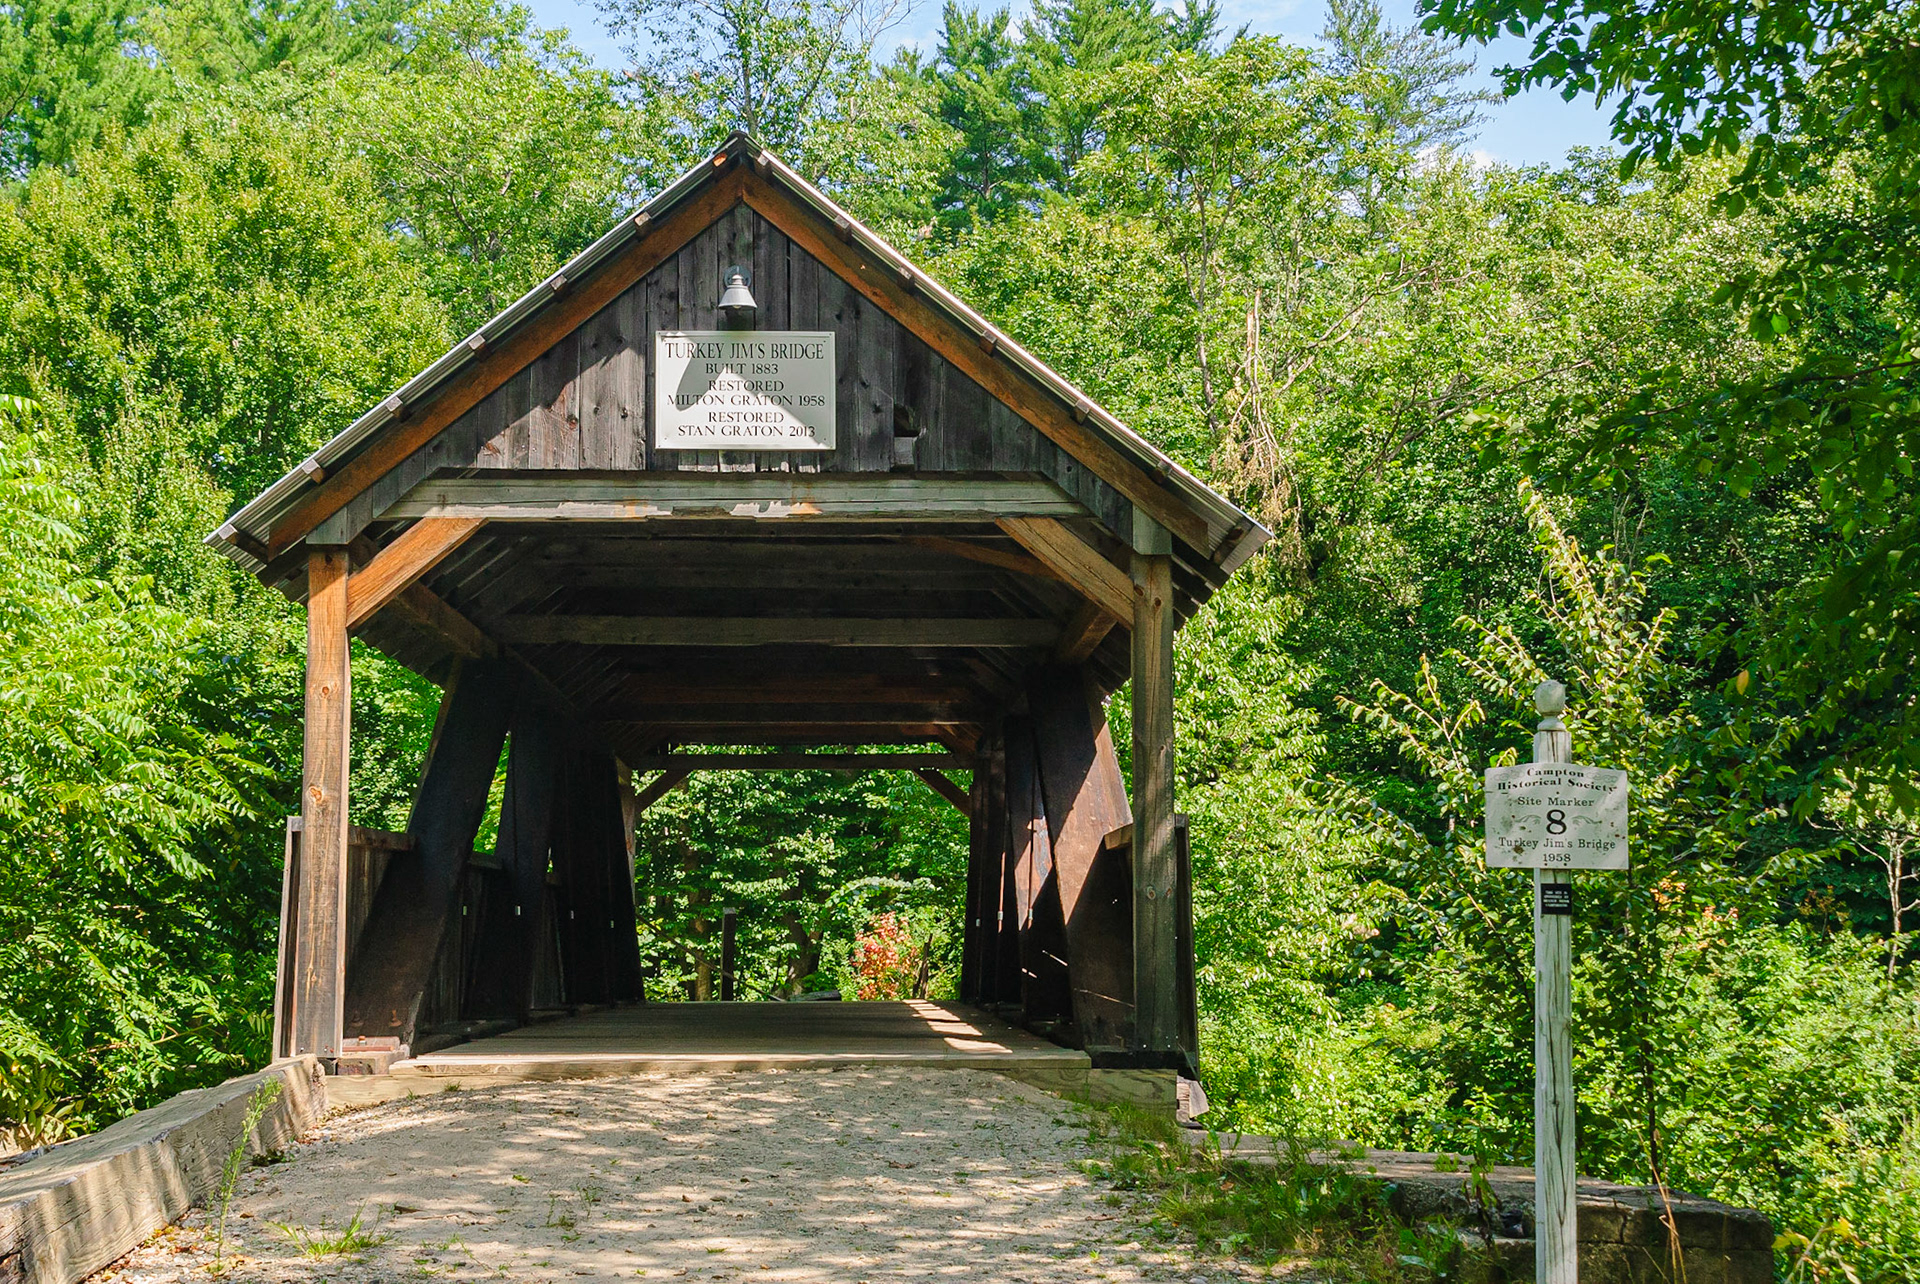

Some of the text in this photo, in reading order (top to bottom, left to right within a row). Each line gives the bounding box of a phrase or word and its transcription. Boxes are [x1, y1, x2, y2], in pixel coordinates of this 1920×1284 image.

[665, 342, 824, 359] TURKEY JIM'S BRIDGE
[705, 363, 779, 374] BUILT 1883
[708, 380, 784, 392] RESTORED
[667, 394, 826, 406] MILTON GRATON 1958
[708, 411, 784, 423] RESTORED
[678, 425, 815, 437] STAN GRATON 2013
[1527, 767, 1584, 778] Campton
[1497, 778, 1618, 794] Historical Society
[1517, 796, 1594, 807] Site Marker
[1546, 809, 1567, 835] 8
[1498, 836, 1616, 851] Turkey Jim's Bridge
[1543, 853, 1571, 862] 1958
